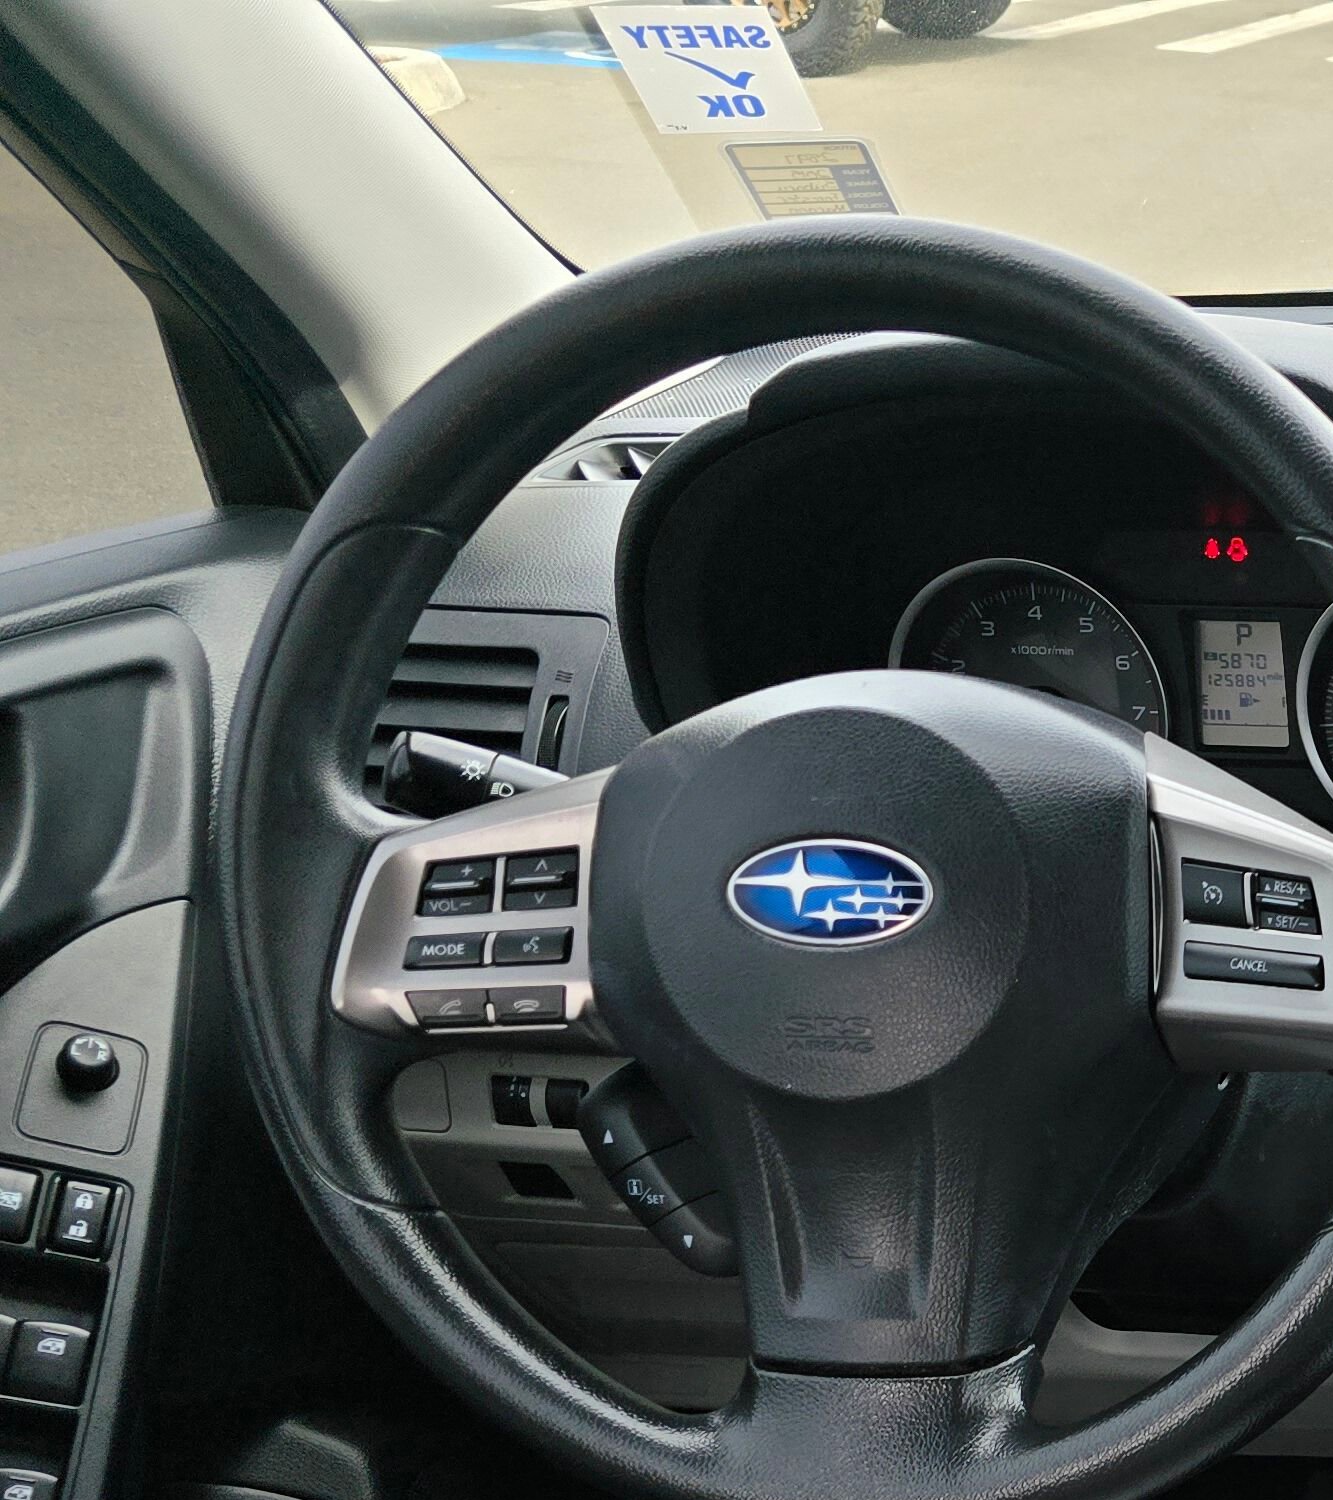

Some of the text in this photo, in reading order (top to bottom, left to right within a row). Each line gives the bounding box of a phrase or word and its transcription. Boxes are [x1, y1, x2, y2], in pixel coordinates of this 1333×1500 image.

[1027, 605, 1042, 621] 4
[981, 621, 995, 636] 3
[1079, 617, 1094, 633] 5
[1235, 624, 1252, 646] P
[1115, 655, 1130, 671] 6
[1218, 652, 1267, 670] 5870
[1208, 673, 1267, 688] 125884
[1132, 706, 1146, 720] 7
[422, 943, 465, 956] MODE
[1230, 957, 1268, 973] CANCEL
